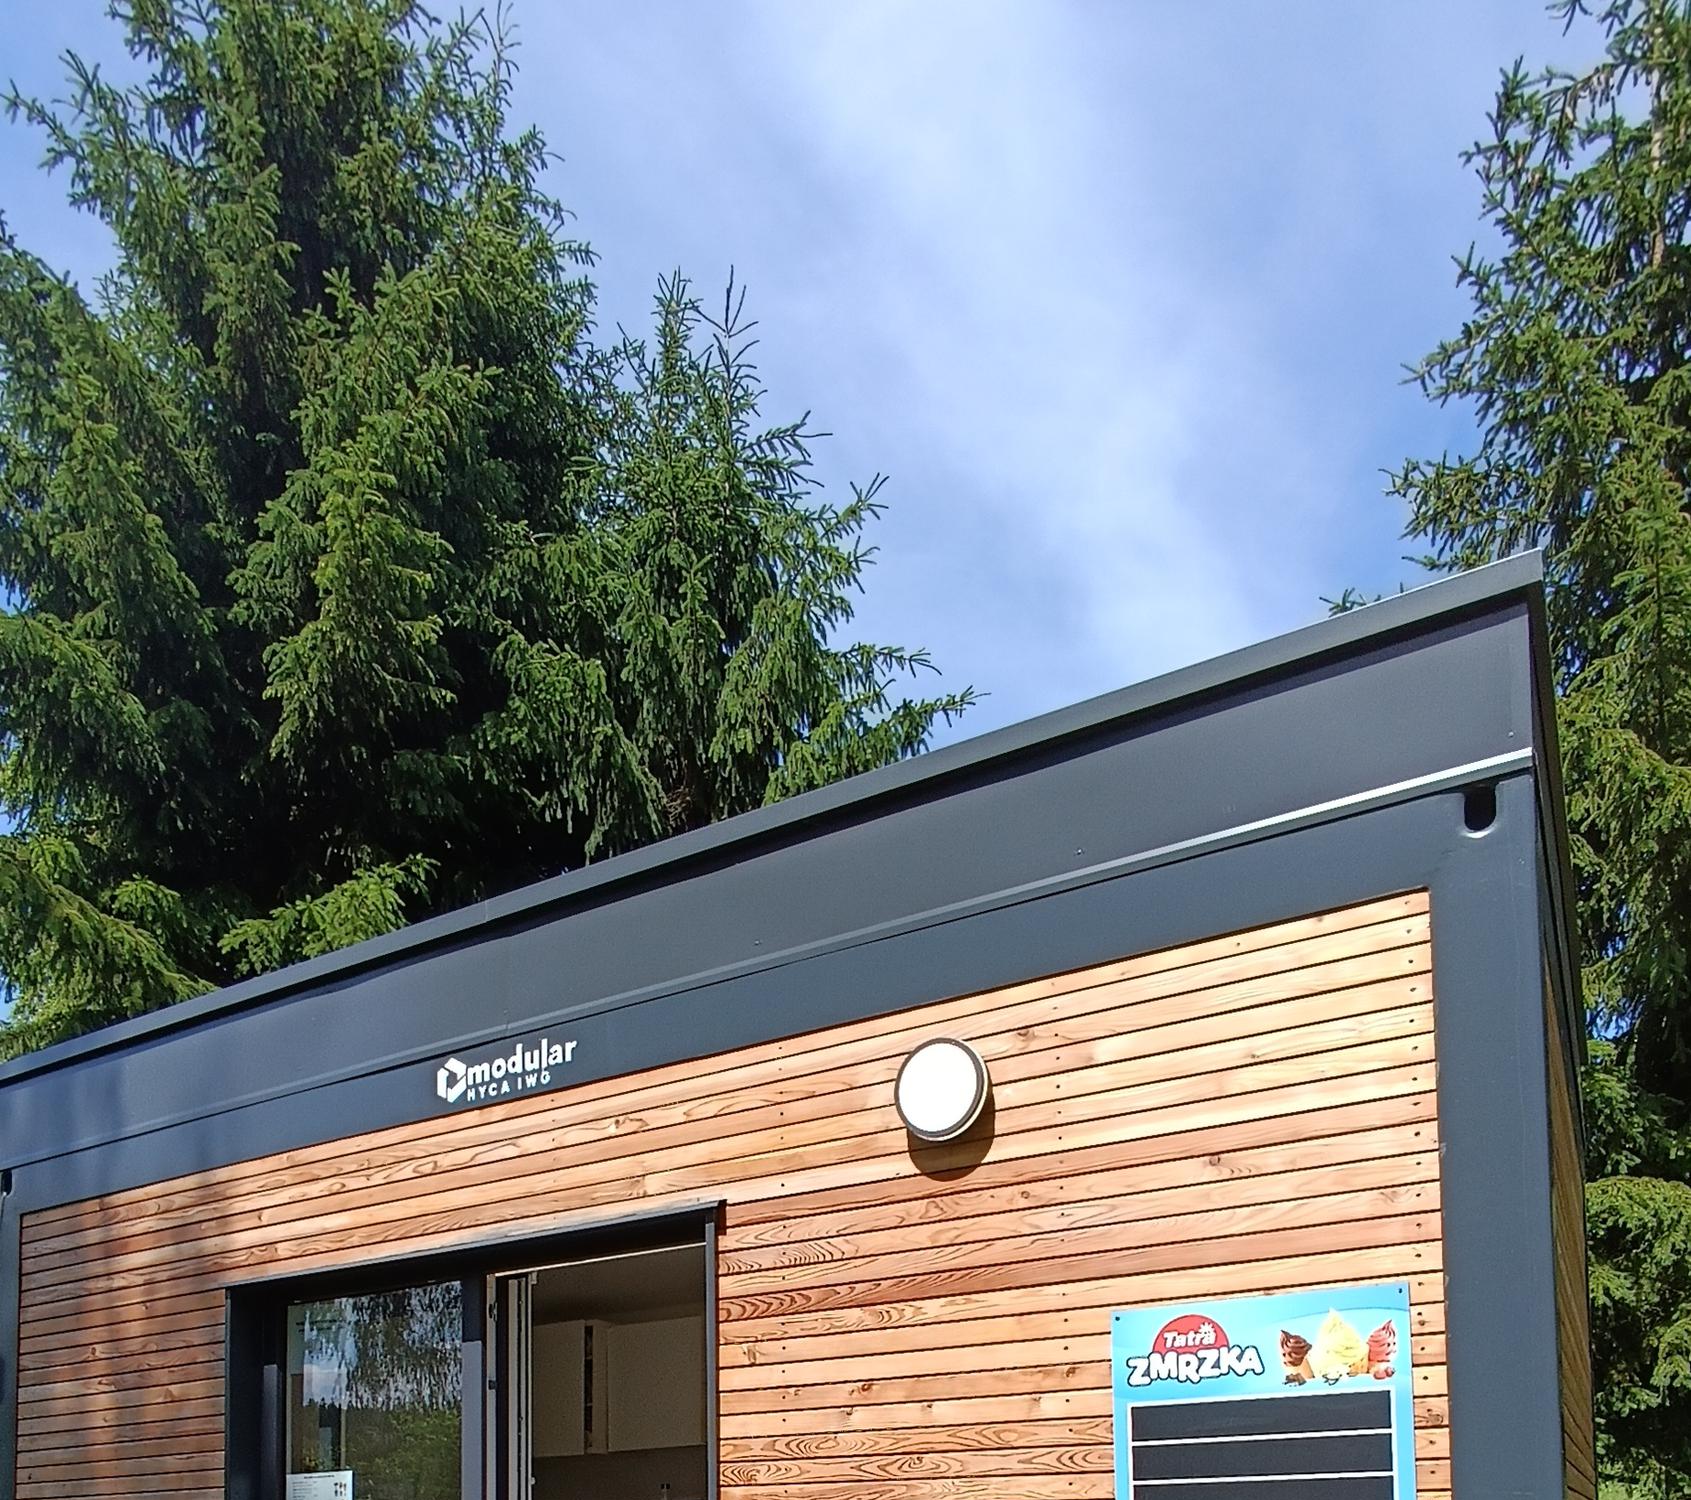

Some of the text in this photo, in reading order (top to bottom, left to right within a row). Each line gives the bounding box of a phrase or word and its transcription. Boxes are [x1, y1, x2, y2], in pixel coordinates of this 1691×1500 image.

[467, 1038, 577, 1085] modular
[467, 1071, 551, 1101] HYCA IWG
[1163, 1325, 1217, 1348] Tatra
[1126, 1344, 1265, 1387] ZMRZKA
